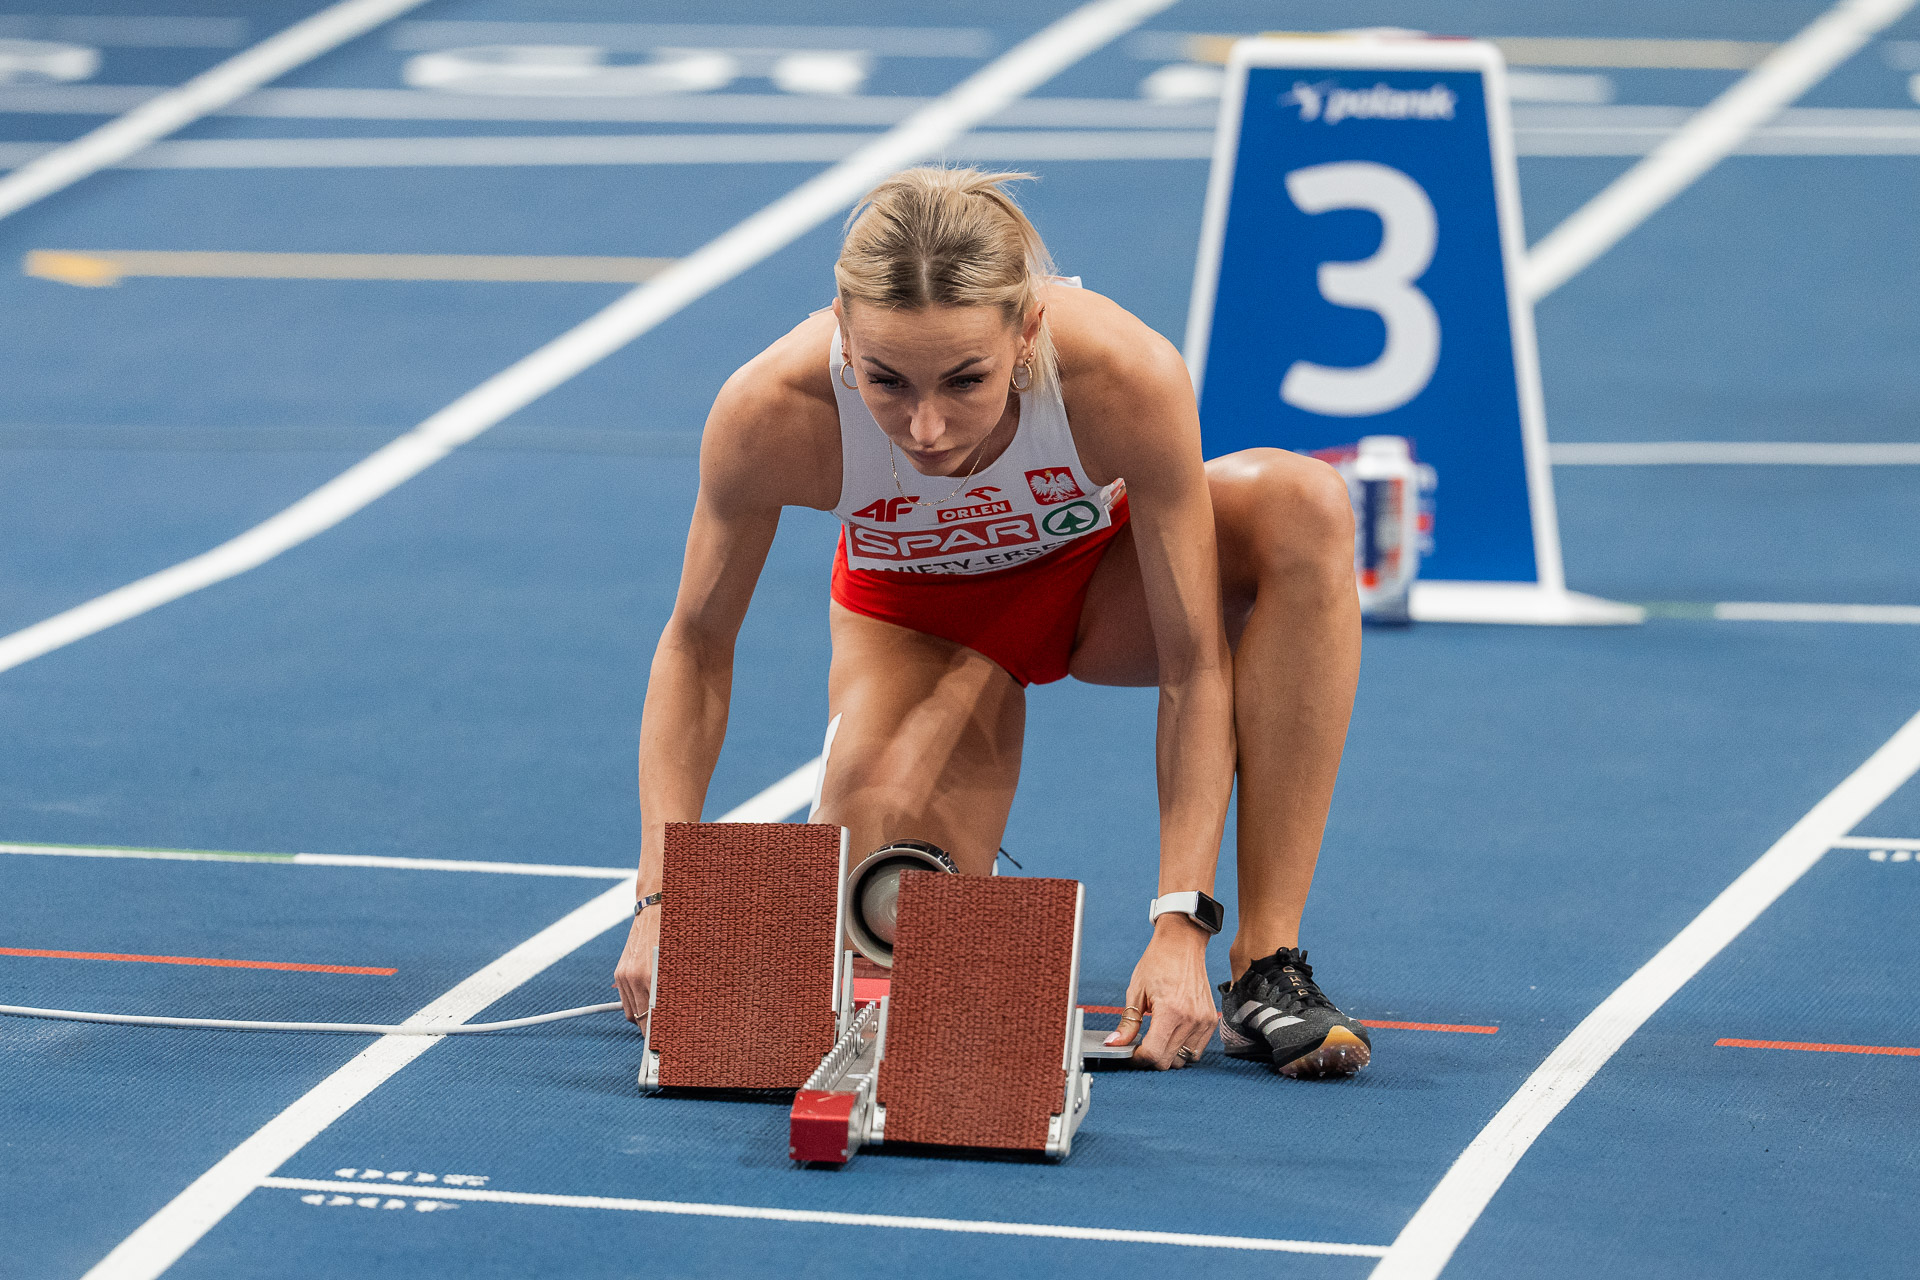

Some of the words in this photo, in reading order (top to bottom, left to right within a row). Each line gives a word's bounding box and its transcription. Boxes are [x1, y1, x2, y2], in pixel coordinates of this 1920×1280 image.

[1280, 160, 1442, 417] 3
[852, 496, 920, 522] 4F
[941, 502, 1007, 520] ORLEN
[854, 519, 1034, 557] SPAR
